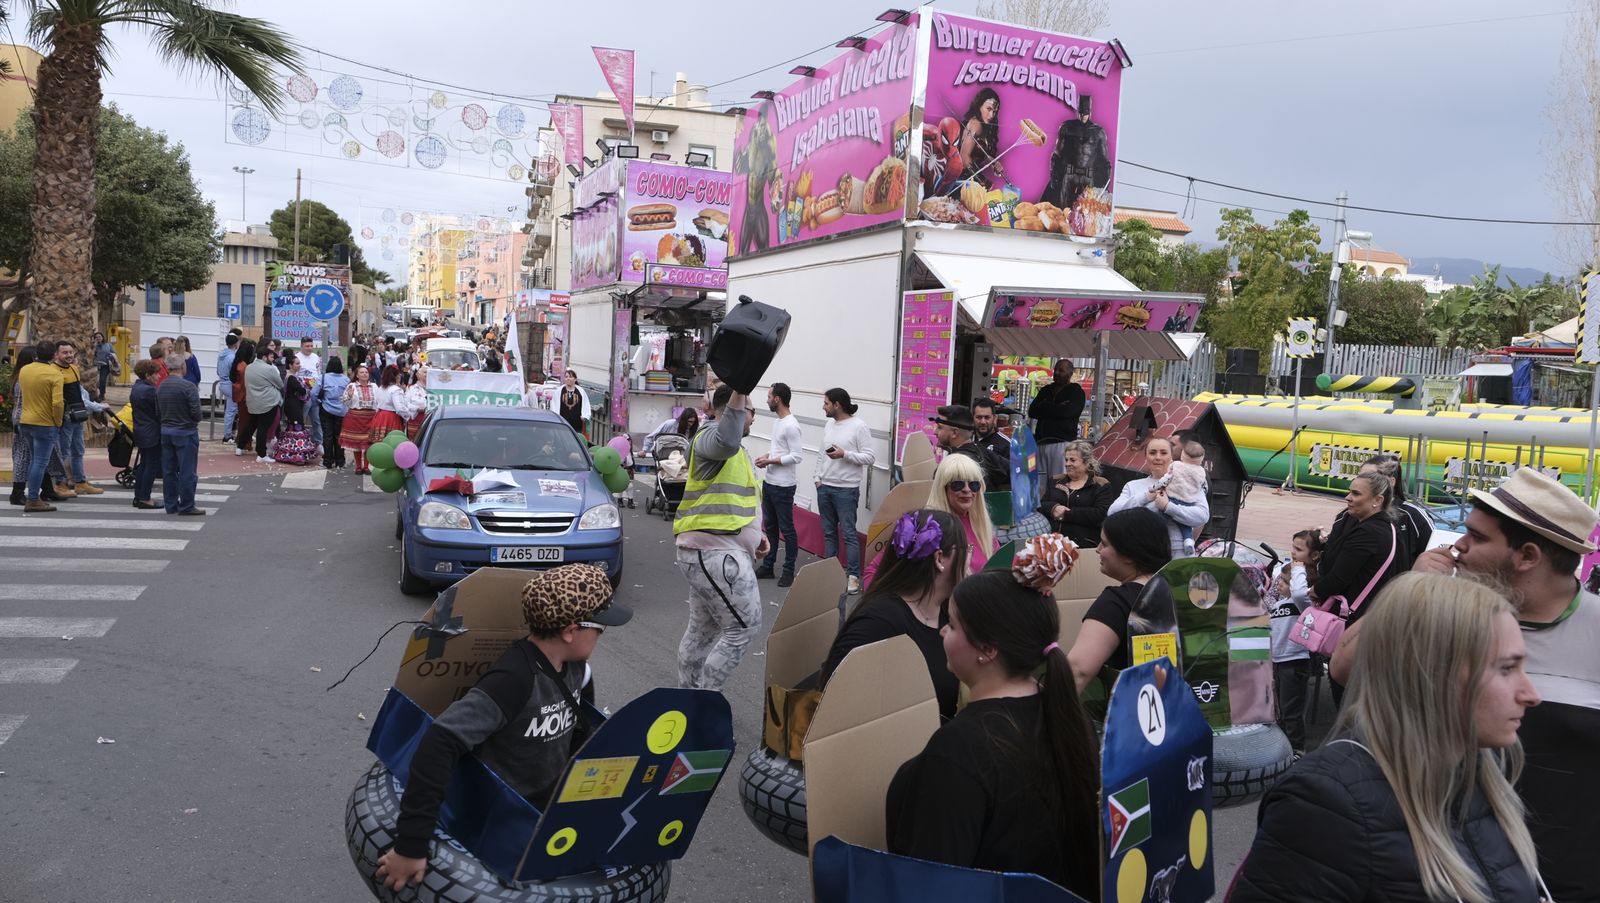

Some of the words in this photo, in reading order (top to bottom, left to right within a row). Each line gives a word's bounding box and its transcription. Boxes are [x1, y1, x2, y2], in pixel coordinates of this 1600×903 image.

[933, 13, 1035, 57] Burguer
[1033, 36, 1117, 79] bocata
[773, 71, 840, 132] Burguer
[840, 22, 917, 98] bocata
[953, 59, 1080, 111] Isabelana
[790, 105, 884, 173] Isabelana
[283, 264, 326, 277] MOJITOS
[227, 305, 238, 318] P
[273, 309, 310, 318] GOFRES
[273, 319, 310, 328] CREPES
[501, 548, 533, 560] 4465
[541, 703, 560, 715] REACH
[1140, 688, 1162, 734] 21
[657, 719, 677, 748] 3
[601, 772, 621, 785] 14
